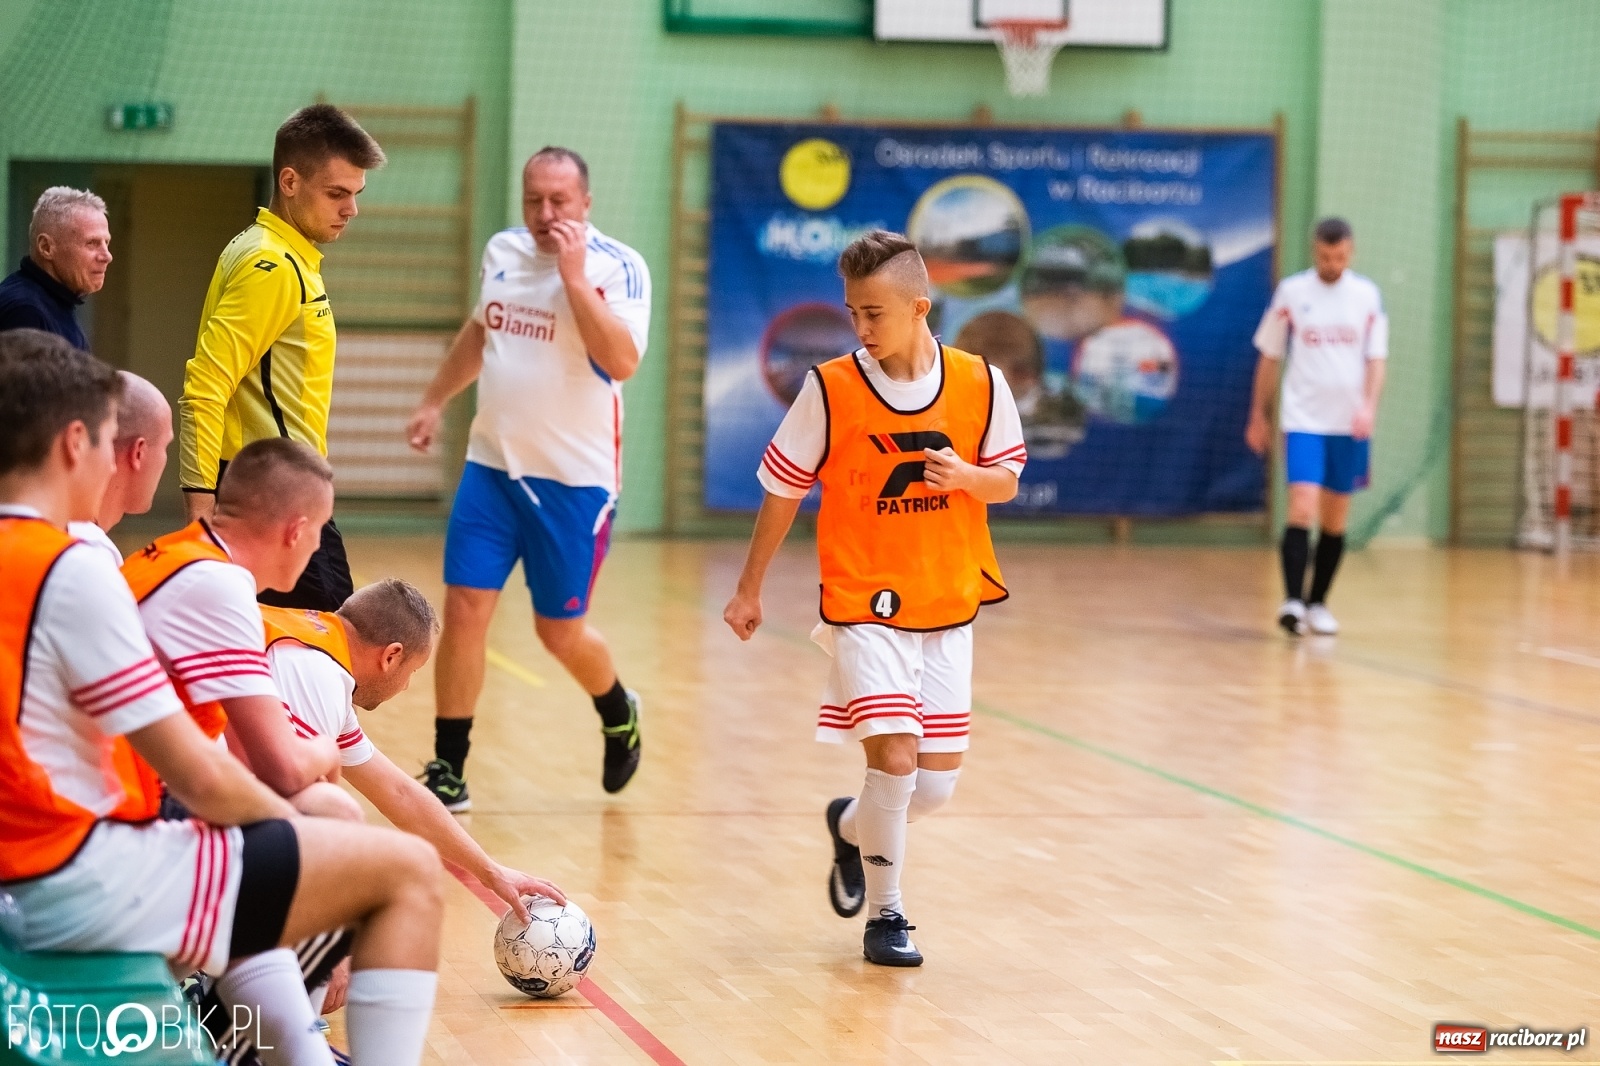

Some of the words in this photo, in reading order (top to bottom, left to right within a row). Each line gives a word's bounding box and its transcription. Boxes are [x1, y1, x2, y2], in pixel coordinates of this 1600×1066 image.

[485, 302, 555, 342] Gianni
[876, 494, 950, 516] PATRICK
[875, 591, 893, 618] 4
